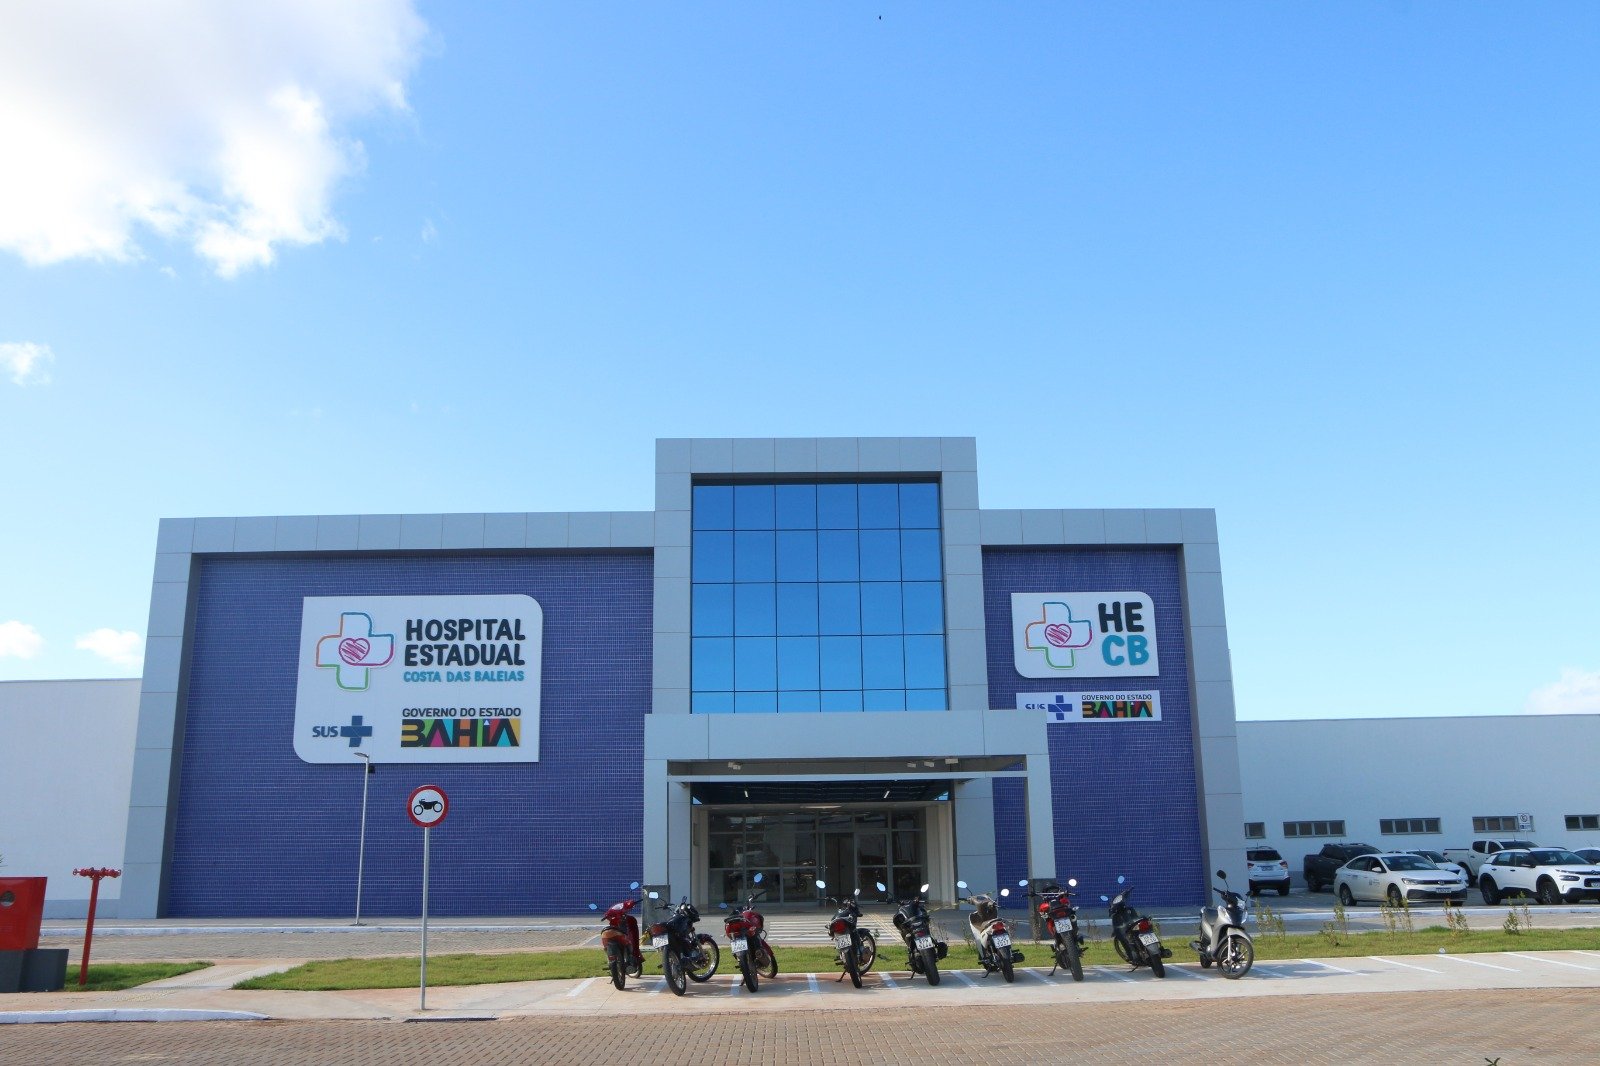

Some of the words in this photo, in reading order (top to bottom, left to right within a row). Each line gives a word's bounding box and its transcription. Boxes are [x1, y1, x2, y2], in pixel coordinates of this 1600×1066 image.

[1098, 601, 1144, 633] HE
[406, 619, 526, 641] HOSPITAL
[404, 644, 525, 666] ESTADUAL
[1102, 635, 1149, 666] CB
[403, 671, 441, 682] COSTA
[446, 671, 470, 682] DAS
[474, 670, 524, 682] BALEIAS
[402, 708, 457, 717] GOVERNO
[460, 708, 476, 717] DO
[479, 708, 521, 717] ESTADO
[1082, 701, 1153, 718] BAHIA
[312, 725, 338, 738] SUS
[401, 718, 520, 747] BAHIA
